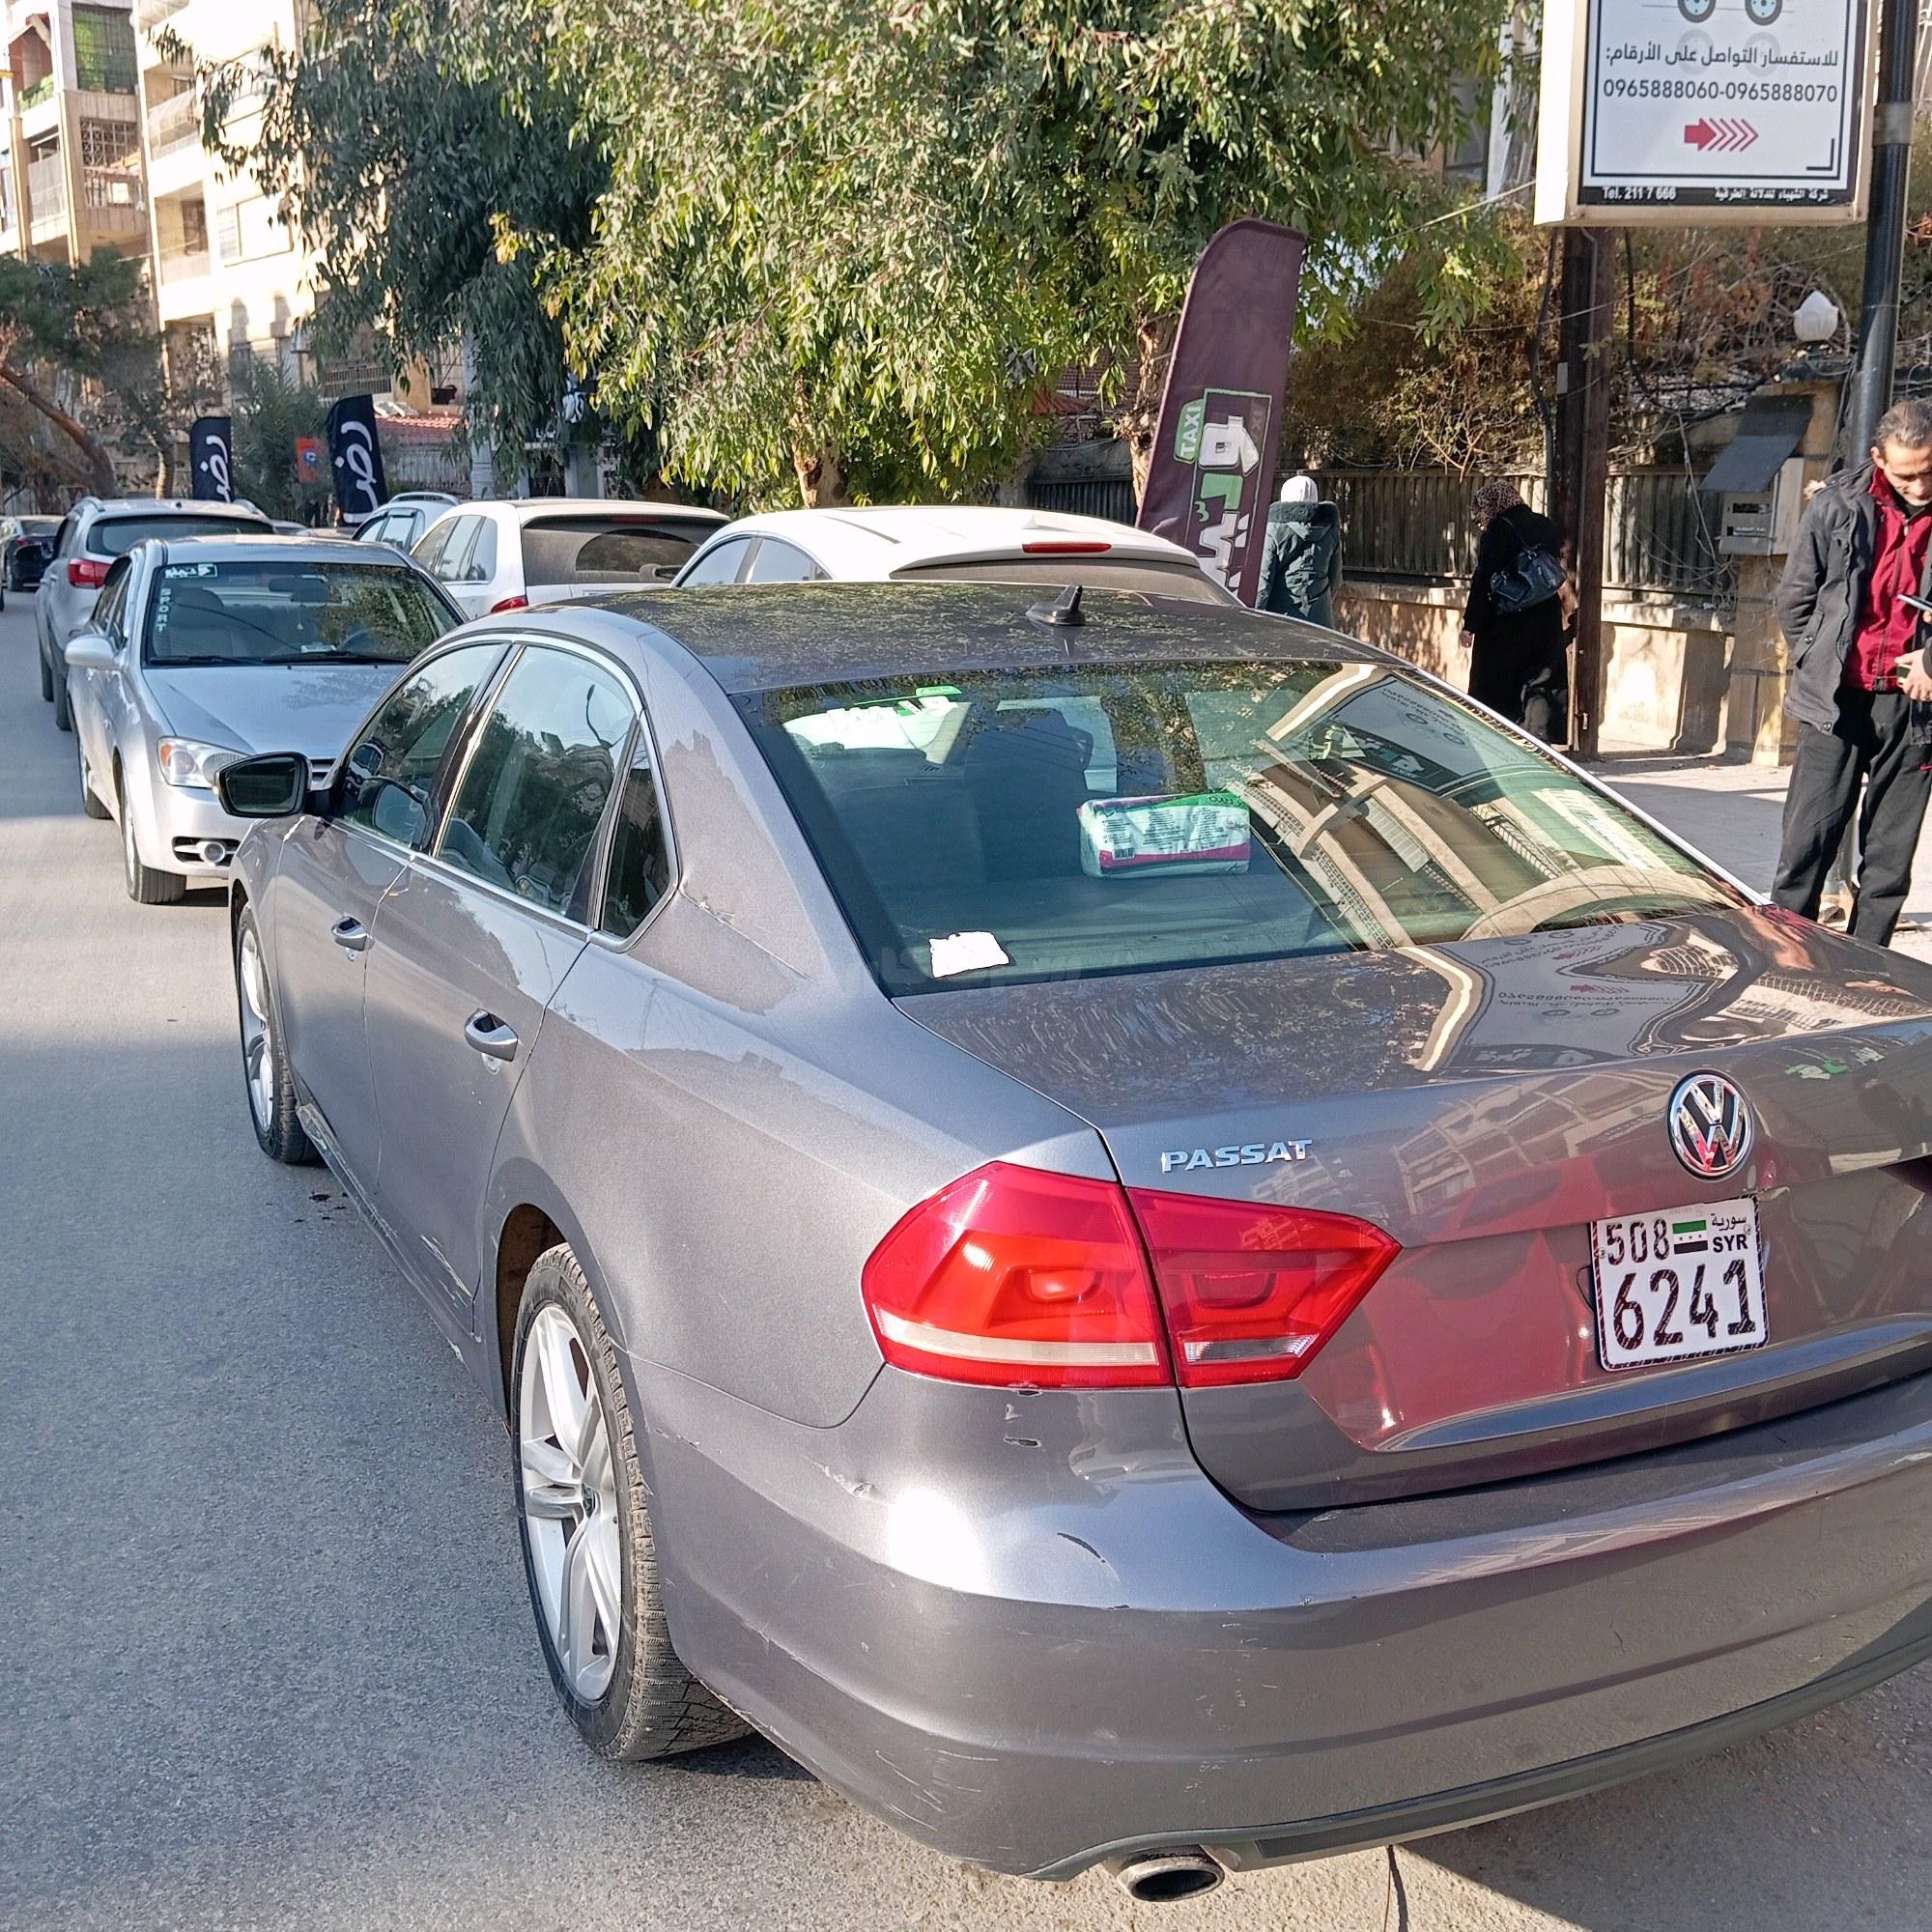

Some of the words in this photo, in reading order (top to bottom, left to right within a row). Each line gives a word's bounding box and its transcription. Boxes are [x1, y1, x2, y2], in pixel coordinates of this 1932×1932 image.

[1605, 42, 1661, 67] الأرقام:
[1664, 44, 1697, 66] على
[1701, 46, 1757, 69] التواصل
[1762, 47, 1838, 68] للاستفسار
[1603, 79, 1837, 102] 0965888060-0965888070
[1602, 185, 1623, 200] Tel.
[1624, 186, 1642, 200] 211
[1646, 186, 1654, 200] 7
[1180, 405, 1202, 458] TAXI
[156, 587, 171, 634] SPORT
[1160, 1139, 1314, 1174] PASSAT
[1710, 1212, 1747, 1232] سورية
[1605, 1219, 1670, 1265] 508
[1712, 1234, 1749, 1254] SYR
[1612, 1258, 1756, 1350] 6241
